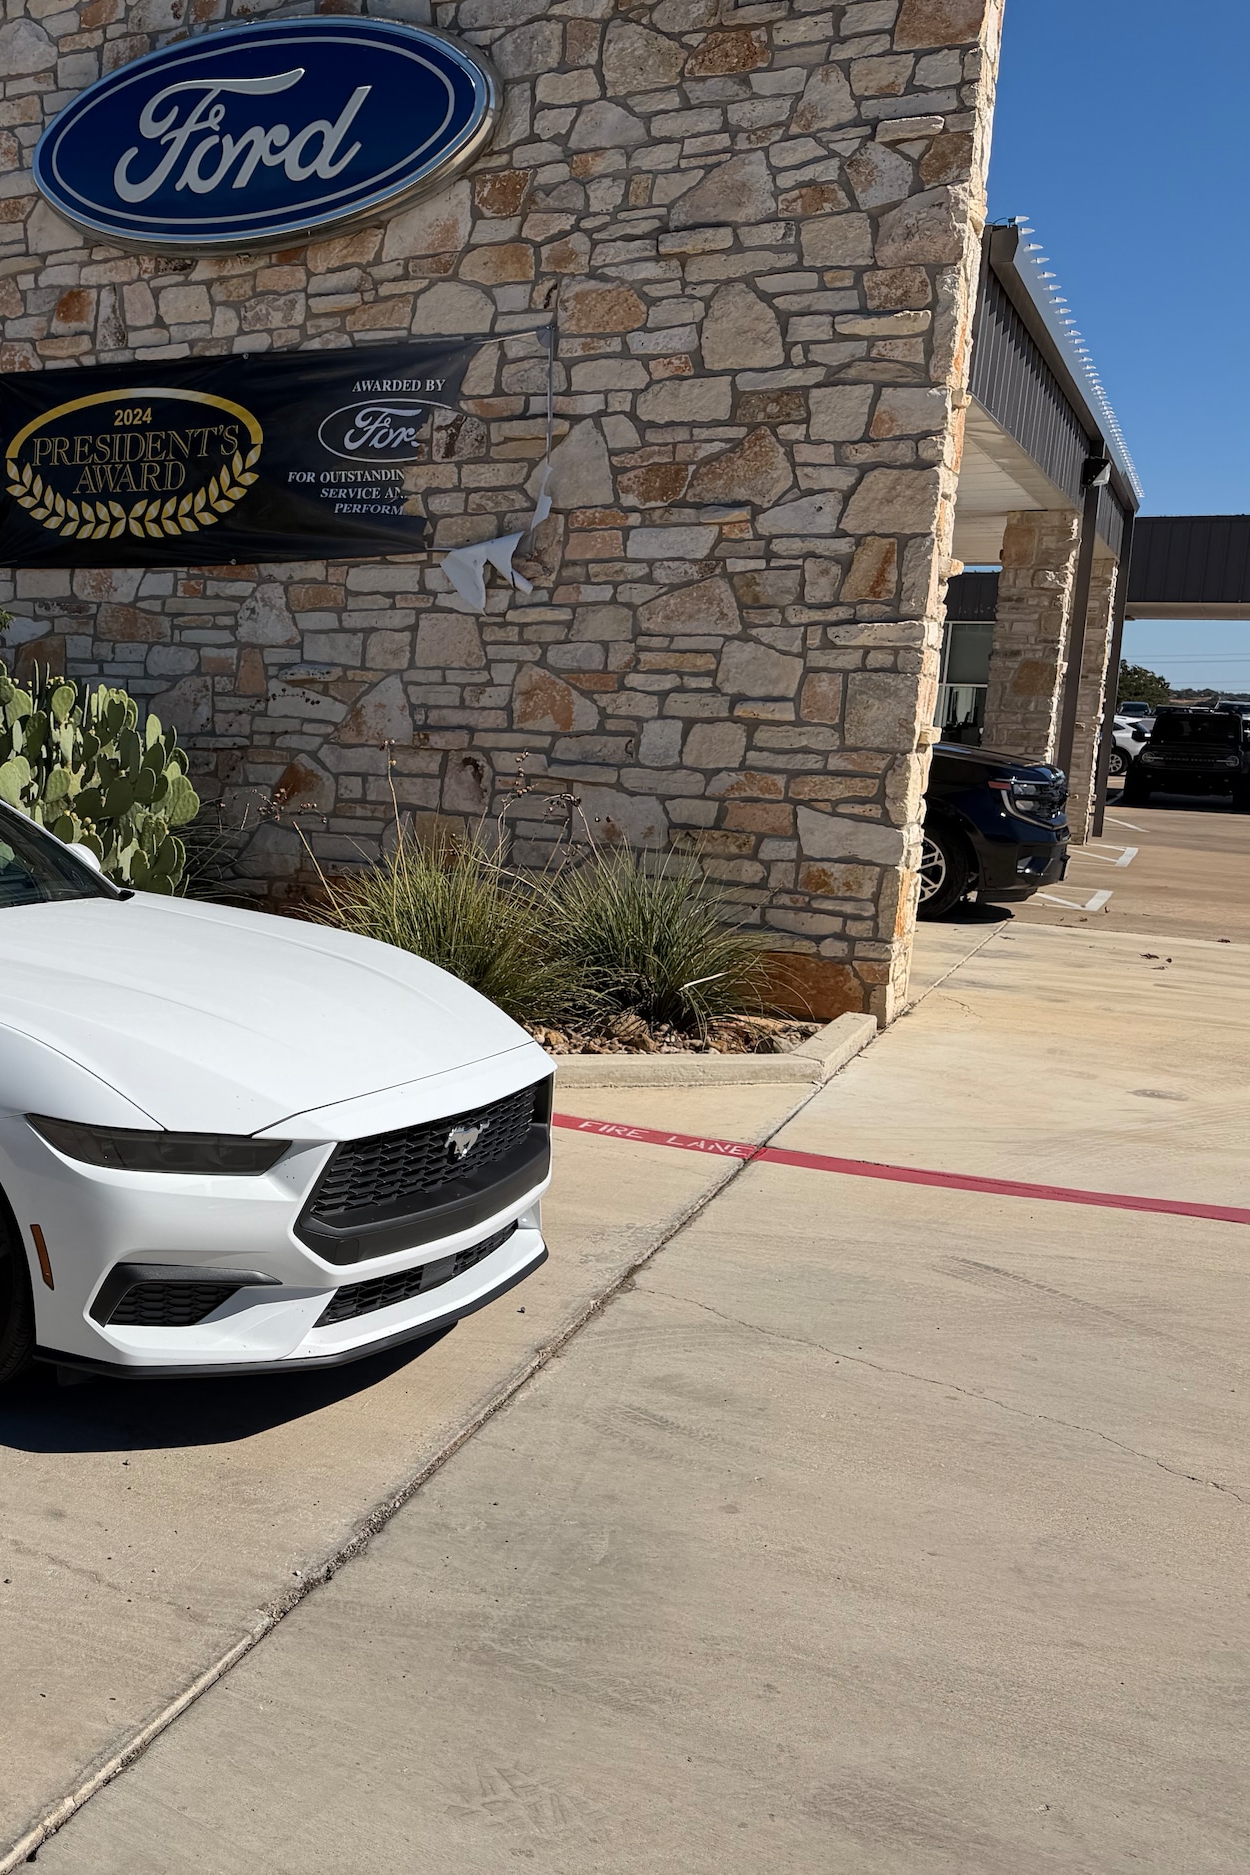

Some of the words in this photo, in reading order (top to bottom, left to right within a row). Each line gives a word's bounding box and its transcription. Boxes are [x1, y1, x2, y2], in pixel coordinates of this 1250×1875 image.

[113, 67, 372, 203] Ford
[352, 379, 421, 392] AWARDED
[425, 379, 446, 392] BY
[113, 407, 152, 426] 2024
[343, 406, 422, 450] For
[31, 424, 239, 467] PRESIDENT'S
[72, 460, 186, 495] AWARD
[287, 471, 316, 483] FOR
[320, 487, 381, 499] SERVICE
[578, 1121, 650, 1139] FIRE
[666, 1136, 756, 1155] LANE
